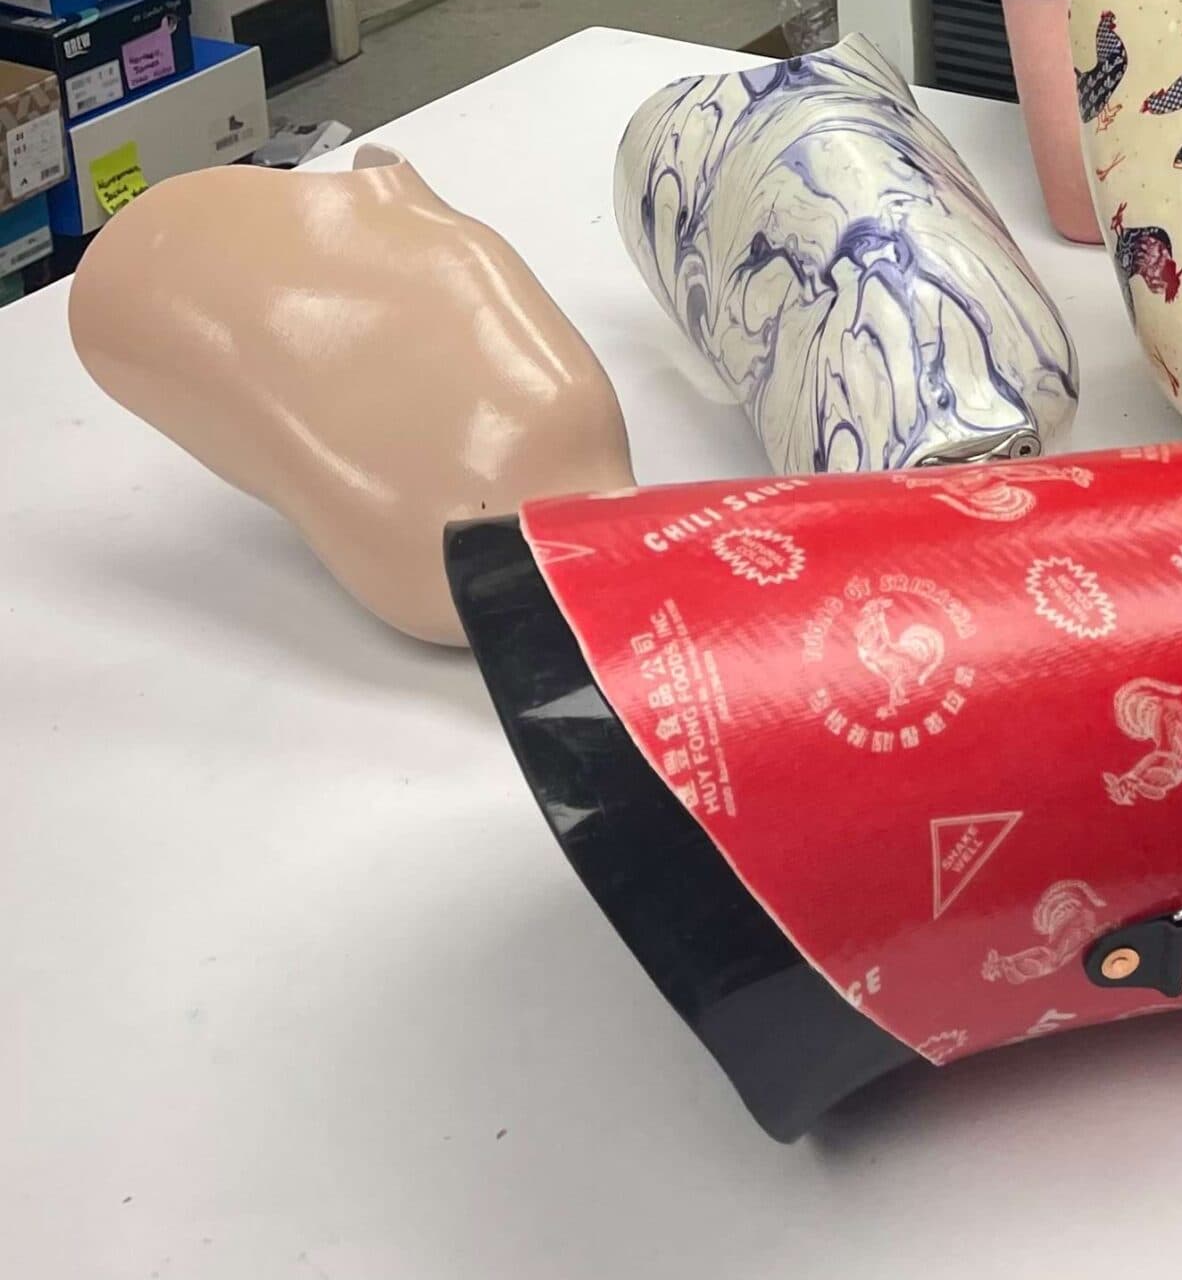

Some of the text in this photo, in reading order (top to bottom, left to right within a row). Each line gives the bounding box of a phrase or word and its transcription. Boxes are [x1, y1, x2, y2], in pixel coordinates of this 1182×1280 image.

[644, 507, 722, 552] CHILI
[683, 705, 709, 765] FONG
[697, 771, 721, 815] HUY
[941, 824, 980, 872] SHAKE
[950, 839, 985, 874] WELL
